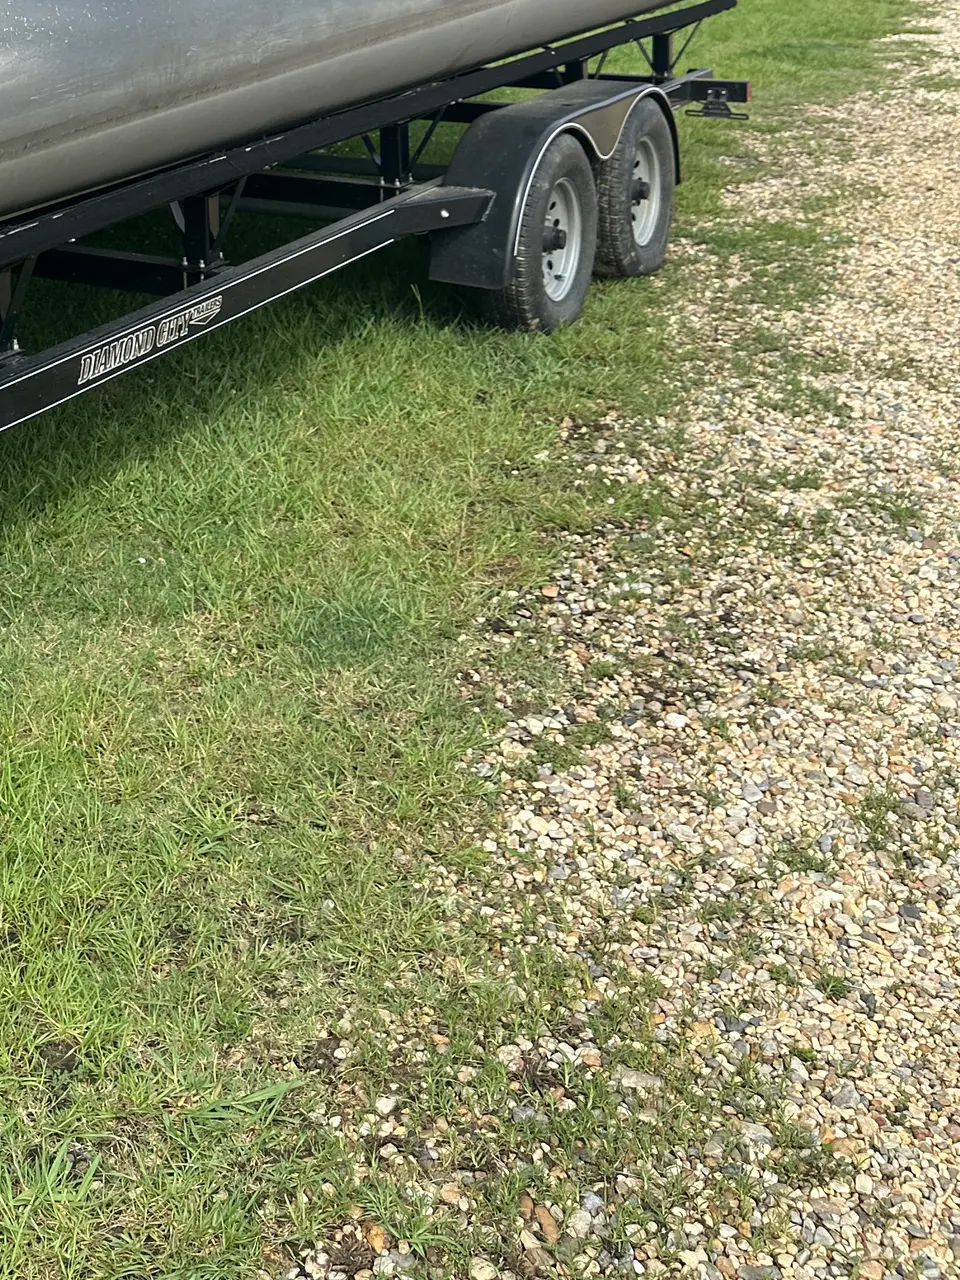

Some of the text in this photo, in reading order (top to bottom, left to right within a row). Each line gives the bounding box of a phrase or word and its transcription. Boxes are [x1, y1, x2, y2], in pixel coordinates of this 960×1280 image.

[77, 295, 222, 385] DIAMOND CITY TRAILERS
